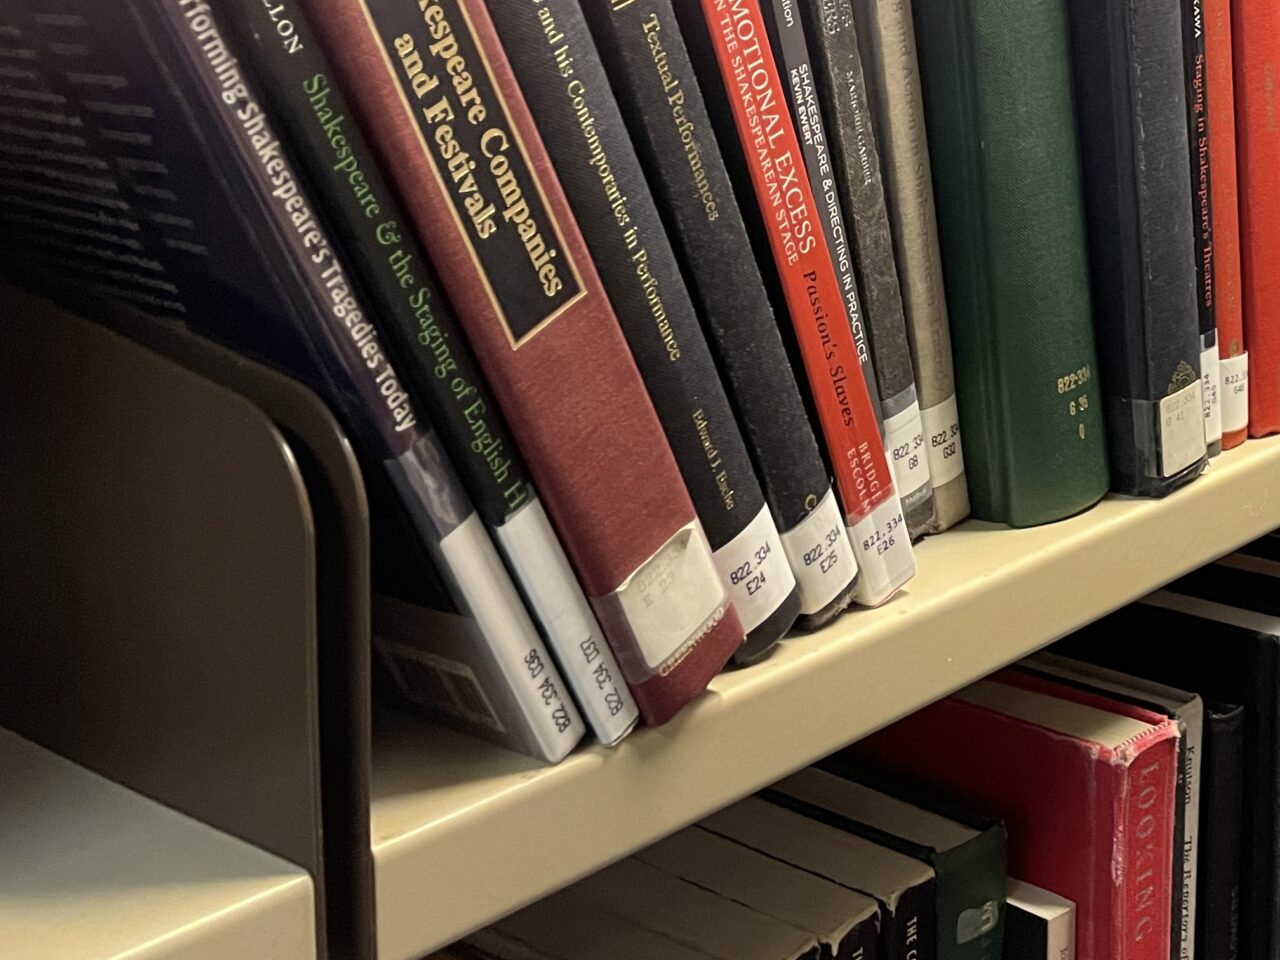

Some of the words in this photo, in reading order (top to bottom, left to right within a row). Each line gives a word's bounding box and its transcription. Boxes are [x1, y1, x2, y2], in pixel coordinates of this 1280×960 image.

[789, 67, 807, 104] KEVIN
[903, 66, 920, 130] Action
[1192, 53, 1204, 113] Staging
[393, 32, 439, 94] and
[423, 92, 498, 242] Festivals
[641, 13, 679, 93] Textual
[666, 89, 720, 224] Performances
[719, 14, 739, 53] THE
[731, 55, 782, 207] SHAKESPEAREAN
[774, 206, 799, 267] STAGE
[796, 104, 814, 146] EWERT
[797, 61, 830, 176] SHAKESPEARE
[482, 126, 565, 298] Companies
[537, 5, 564, 46] and
[553, 44, 575, 79] his
[567, 79, 629, 228] Contemporaries
[623, 226, 639, 252] in
[631, 248, 681, 362] Performance
[774, 149, 817, 256] EXCESS
[822, 177, 833, 192] &
[1198, 136, 1209, 240] Shakespeare's
[825, 191, 850, 273] DIRECTING
[237, 100, 329, 267] Shakespeare's
[318, 253, 387, 370] Tragedies
[376, 361, 417, 434] Today
[302, 72, 382, 220] Shakespeare
[375, 219, 402, 246] &
[389, 249, 414, 288] the
[409, 287, 457, 378] Staging
[450, 376, 477, 400] of
[464, 396, 510, 483] English
[842, 273, 852, 291] IN
[1203, 242, 1213, 308] Theatres
[803, 269, 839, 360] Passion's
[829, 364, 856, 428] Slaves
[845, 291, 868, 366] PRACTICE
[908, 455, 919, 470] G8
[730, 541, 771, 585] 822.334
[803, 526, 842, 567] 822.334
[820, 553, 839, 575] E25
[862, 513, 903, 553] 822.334
[877, 537, 896, 557] E26
[746, 572, 767, 596] E24
[1184, 744, 1196, 806] Knutson
[1134, 760, 1159, 942] LOOKING
[906, 916, 918, 945] THE
